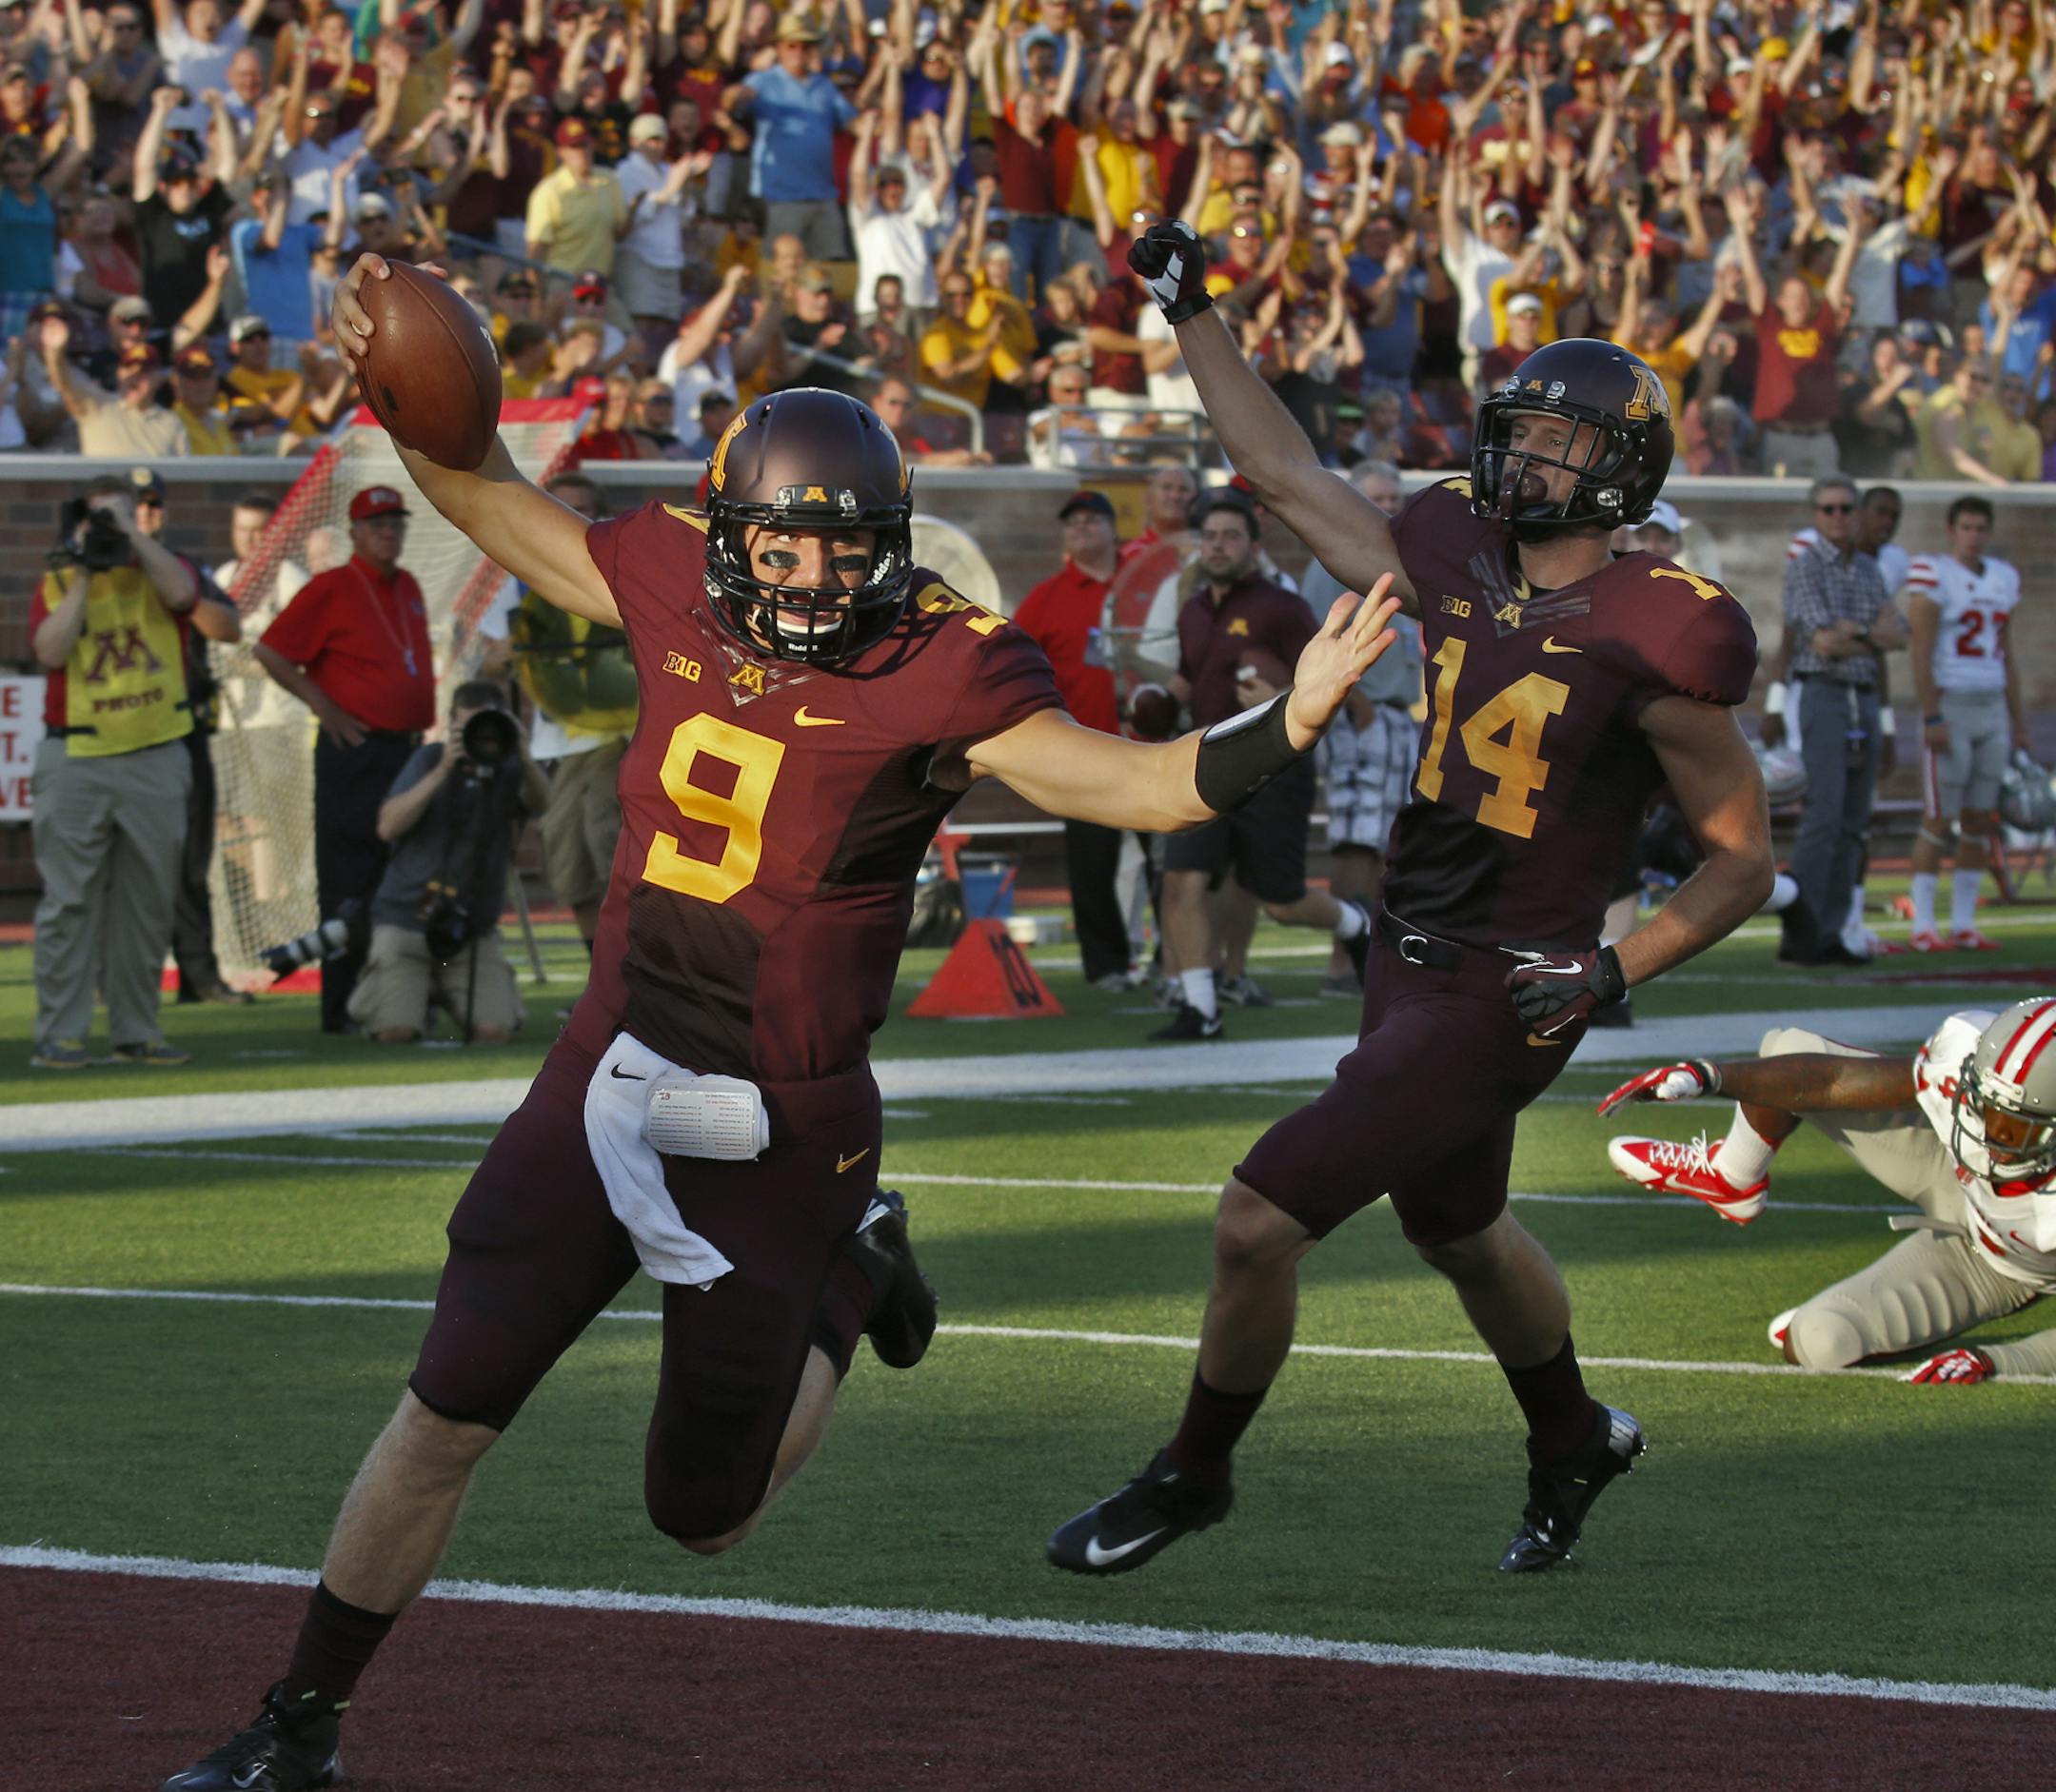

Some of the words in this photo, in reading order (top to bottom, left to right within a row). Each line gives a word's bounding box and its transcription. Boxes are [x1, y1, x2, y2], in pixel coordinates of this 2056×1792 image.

[92, 687, 164, 713] PHOTO
[1416, 636, 1571, 839] 14
[642, 711, 786, 905] 9
